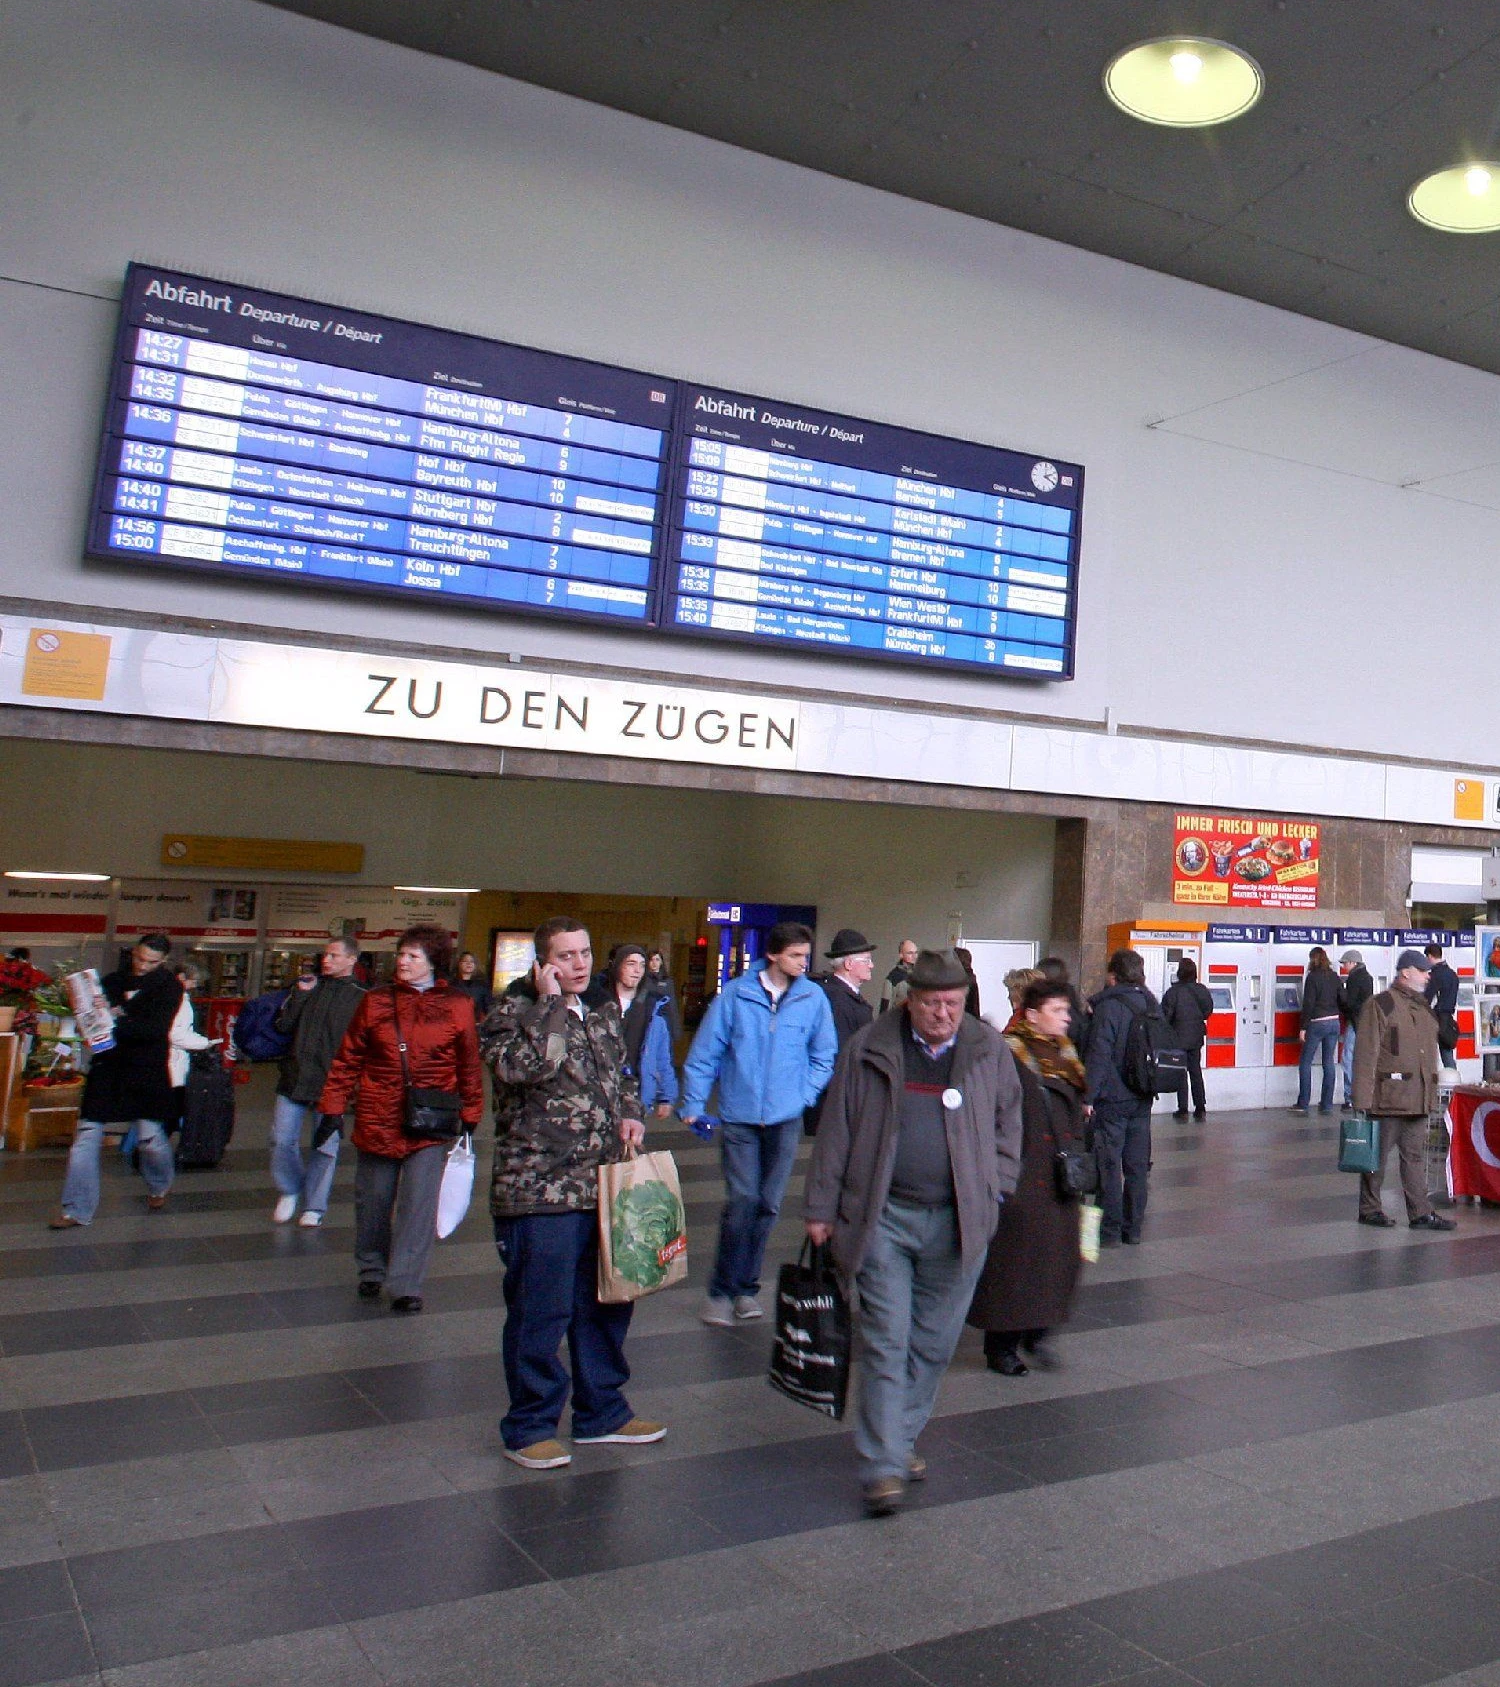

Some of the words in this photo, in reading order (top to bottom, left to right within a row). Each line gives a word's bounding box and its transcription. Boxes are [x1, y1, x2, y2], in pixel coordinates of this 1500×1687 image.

[145, 280, 233, 314] Abfahrt
[240, 302, 320, 330] Departure
[335, 322, 384, 344] Départ
[143, 331, 182, 350] 14:27
[141, 346, 180, 365] 14:31
[138, 368, 177, 387] 14:32
[135, 383, 174, 402] 14:35
[425, 387, 503, 413] Frankfurt(M)
[507, 399, 528, 417] Hbf
[132, 405, 171, 423] 14:36
[386, 417, 401, 427] Hbf
[424, 400, 479, 422] München
[483, 410, 505, 426] Hbf
[565, 413, 573, 426] 7
[694, 395, 756, 422] Abfahrt
[760, 412, 820, 435] Departure
[830, 426, 866, 444] Départ
[298, 435, 315, 448] Hbf
[422, 421, 520, 449] Hamburg-Altona
[126, 443, 166, 460] 14:37
[420, 435, 446, 451] Ffm
[494, 447, 526, 464] Regio
[694, 440, 722, 455] 15:05
[124, 457, 164, 475] 14:40
[418, 455, 440, 469] Hof
[444, 459, 467, 474] Hbf
[559, 460, 568, 472] 9
[691, 452, 721, 467] 15:09
[235, 464, 262, 476] Lauda
[390, 489, 407, 499] Hbf
[416, 468, 472, 490] Bayreuth
[476, 476, 497, 493] Hbf
[552, 479, 566, 492] 10
[691, 470, 719, 485] 15:22
[121, 479, 162, 497] 14:40
[689, 483, 718, 498] 15:29
[896, 478, 937, 496] München
[939, 487, 955, 499] Hbf
[119, 494, 158, 512] 14:41
[414, 489, 472, 510] Stuttgart
[476, 498, 497, 513] Hbf
[549, 492, 564, 504] 10
[230, 500, 256, 512] Fulda
[270, 506, 315, 520] Göttingen
[328, 515, 369, 529] Hannover
[372, 522, 389, 531] Hbf
[411, 502, 468, 527] Nürnberg
[473, 510, 494, 526] Hbf
[553, 513, 562, 524] 2
[688, 502, 716, 517] 15:30
[895, 508, 936, 524] Karlstadt
[116, 516, 156, 535] 14:56
[552, 525, 560, 537] 8
[894, 520, 934, 537] München
[937, 528, 953, 540] Hbf
[996, 527, 1003, 537] 2
[113, 532, 154, 549] 15:00
[410, 524, 509, 551] Hamburg-Altona
[685, 534, 714, 548] 15:33
[290, 545, 307, 555] Hbf
[320, 550, 364, 563] Frankfurt
[409, 537, 491, 562] Treuchtlingen
[551, 546, 559, 557] 7
[892, 536, 965, 558] Hamburg-Altona
[223, 551, 271, 565] Gemünden
[548, 559, 557, 571] 3
[891, 549, 926, 566] Bremen
[930, 554, 945, 567] Hbf
[405, 557, 435, 574] Köln
[439, 562, 461, 578] Hbf
[682, 565, 710, 580] 15:34
[890, 566, 917, 581] Erfurt
[921, 571, 937, 584] Hbf
[404, 573, 441, 589] Jossa
[546, 579, 555, 590] 6
[681, 577, 709, 592] 15:35
[889, 579, 946, 598] Hammelburg
[988, 583, 998, 594] 10
[680, 596, 708, 611] 15:35
[889, 596, 913, 610] Wien
[916, 601, 951, 616] Westbf
[987, 594, 998, 604] 10
[678, 609, 707, 625] 15:40
[946, 616, 963, 628] Hbf
[887, 626, 934, 642] Crailsheim
[885, 637, 927, 656] Nürnberg
[930, 643, 945, 656] Hbf
[364, 674, 443, 719] ZU
[479, 685, 589, 732] DEN
[621, 700, 796, 752] ZÜGEN
[1176, 816, 1214, 832] IMMER
[1218, 819, 1253, 834] FRISCH
[1257, 822, 1279, 836] UND
[1283, 823, 1318, 839] LECKER
[1280, 929, 1307, 937] Fahrkarten
